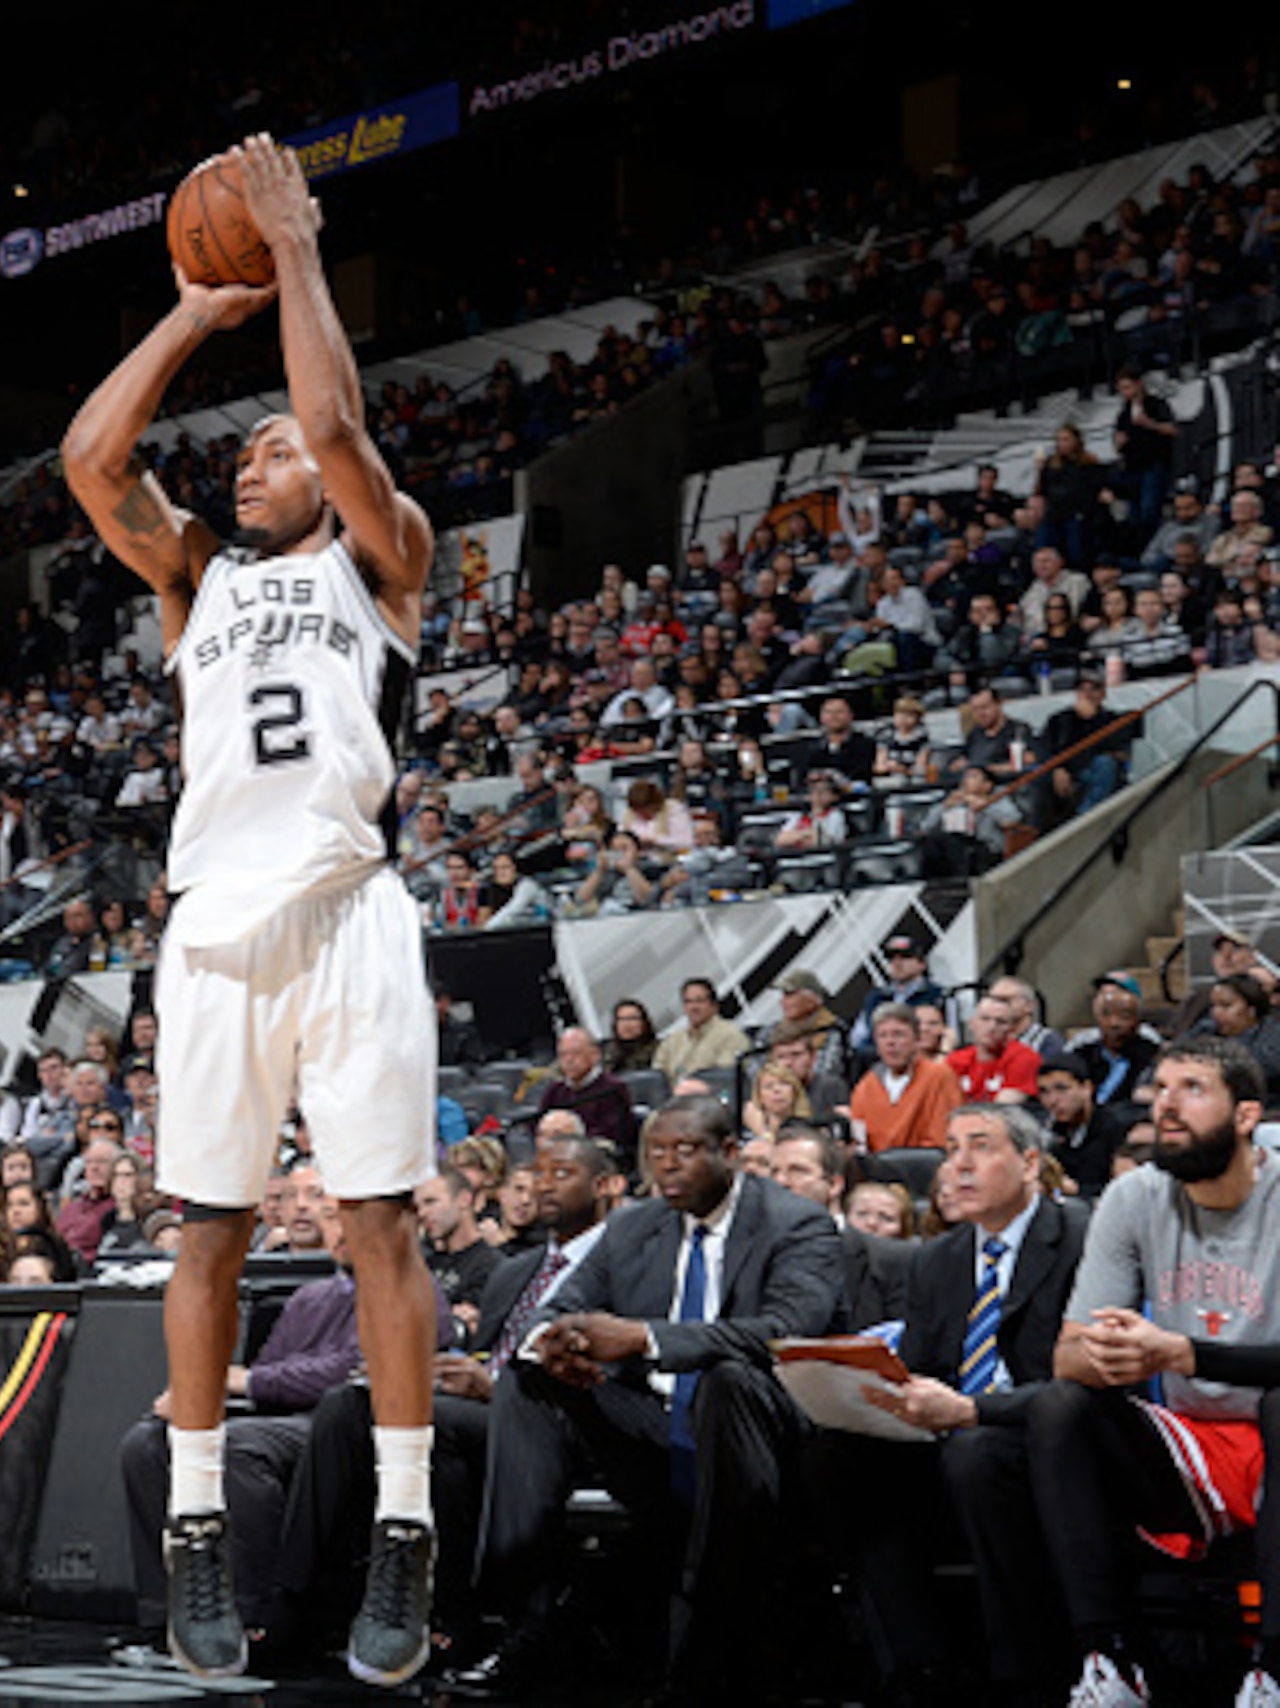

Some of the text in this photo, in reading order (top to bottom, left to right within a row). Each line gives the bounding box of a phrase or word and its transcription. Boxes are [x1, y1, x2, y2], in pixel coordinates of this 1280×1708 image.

[470, 0, 755, 115] Americus Diamond
[45, 192, 167, 258] SOUTHWEST
[230, 578, 315, 611] LOS
[194, 613, 360, 671] SPURS
[248, 683, 312, 766] 2
